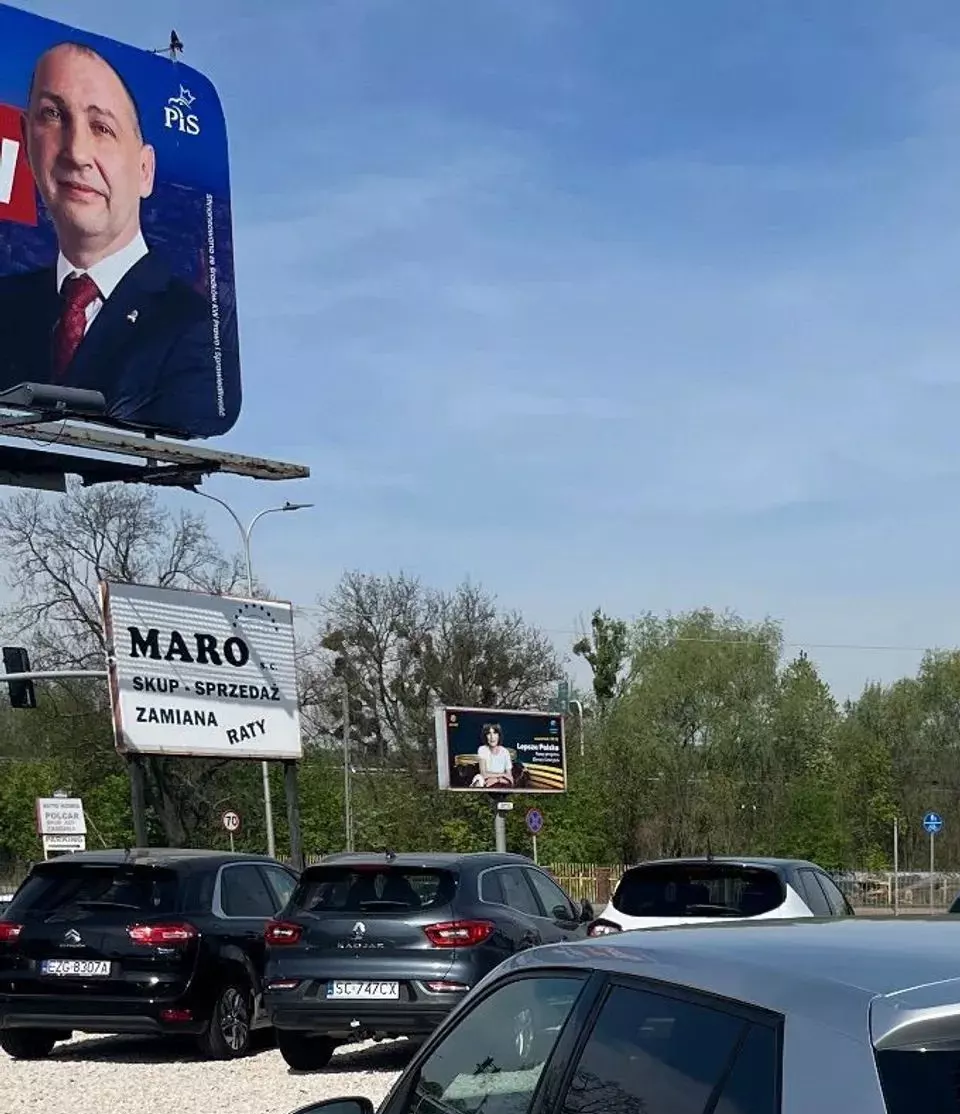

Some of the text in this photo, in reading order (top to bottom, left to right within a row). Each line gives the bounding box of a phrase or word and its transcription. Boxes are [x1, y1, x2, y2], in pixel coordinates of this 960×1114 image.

[128, 626, 250, 667] MARO
[132, 676, 179, 693] SKUP
[194, 681, 281, 701] SPRZEDAŻ
[136, 707, 219, 727] ZAMIANA
[226, 719, 267, 745] RATY
[45, 812, 79, 820] POLCAR
[225, 816, 237, 826] 70
[73, 961, 108, 973] 8307A
[336, 982, 397, 995] SC 747CX
